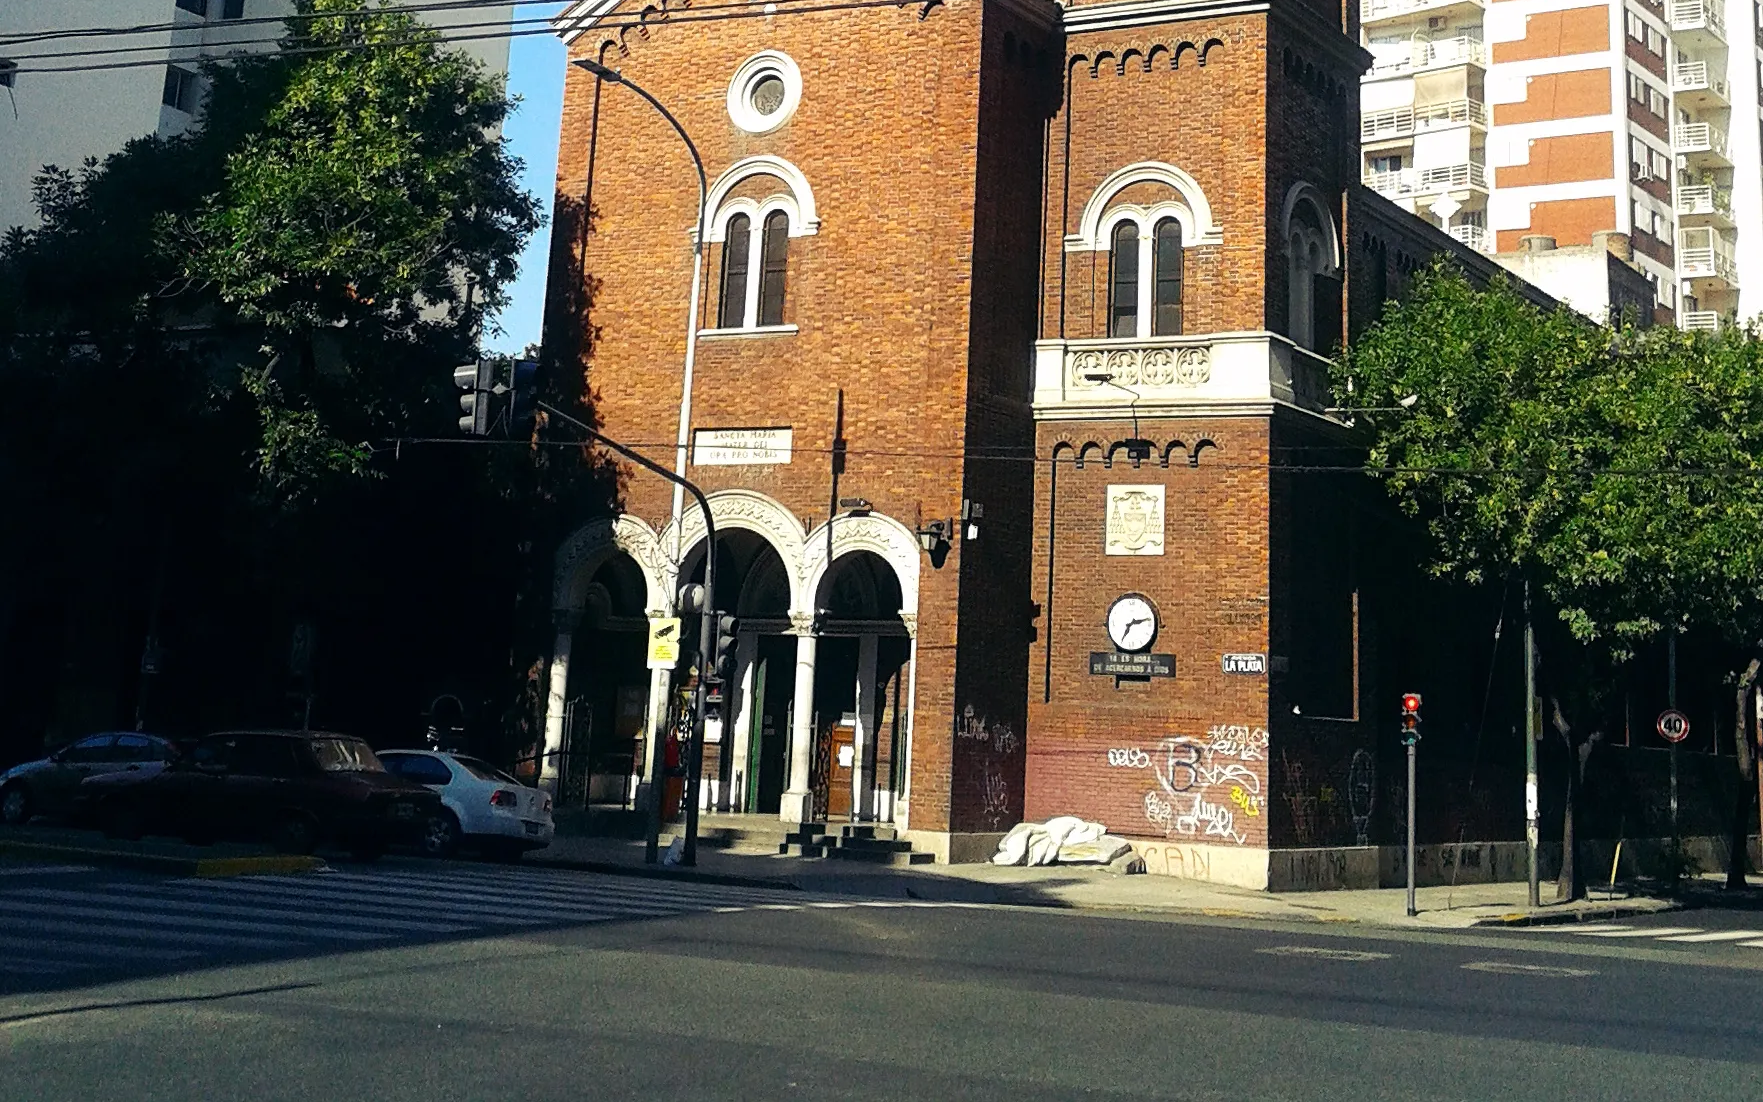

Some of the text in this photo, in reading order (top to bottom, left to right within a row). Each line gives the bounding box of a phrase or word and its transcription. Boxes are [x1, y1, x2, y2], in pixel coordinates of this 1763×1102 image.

[1224, 660, 1263, 672] LA PLATA
[1663, 717, 1683, 734] 40
